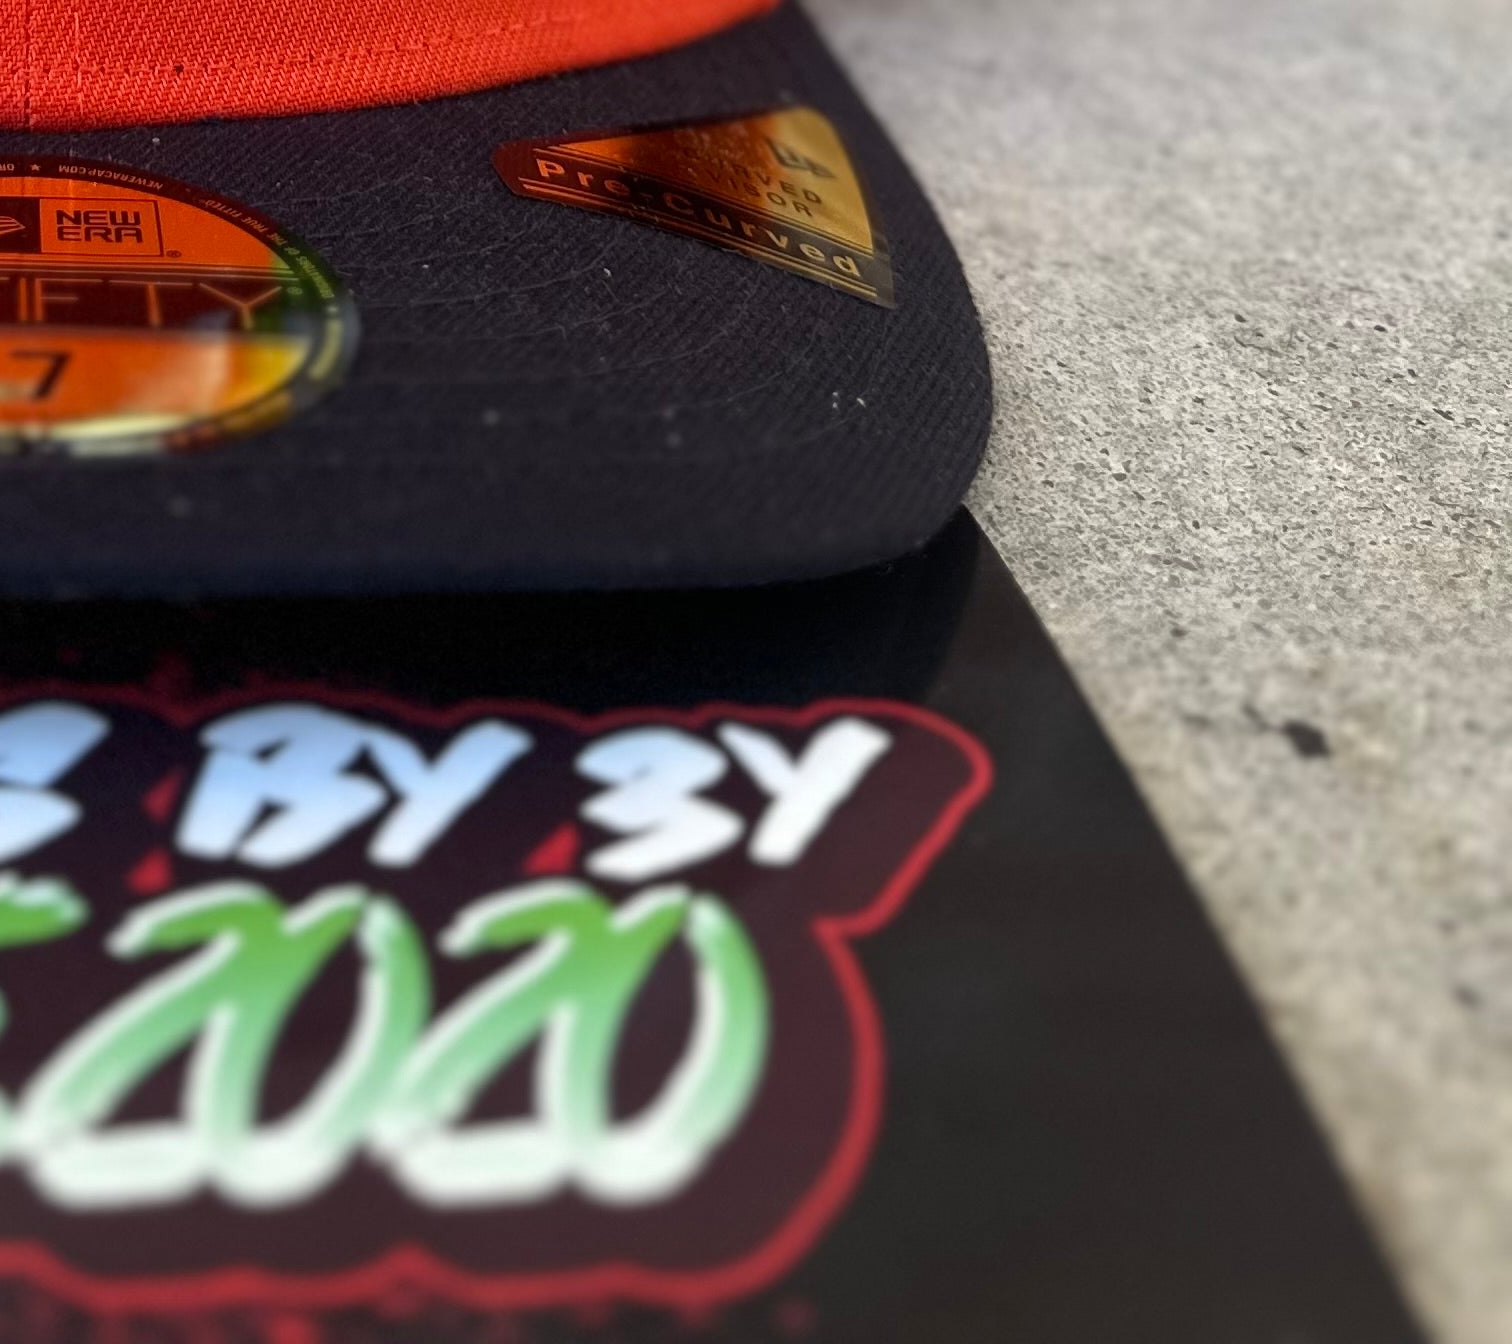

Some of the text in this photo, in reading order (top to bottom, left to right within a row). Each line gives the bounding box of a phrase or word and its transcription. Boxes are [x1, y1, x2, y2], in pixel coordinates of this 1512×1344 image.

[704, 167, 813, 217] VISOR
[55, 209, 141, 226] NEW
[55, 226, 144, 244] ERA
[9, 349, 73, 401] 7
[175, 703, 533, 868] BY
